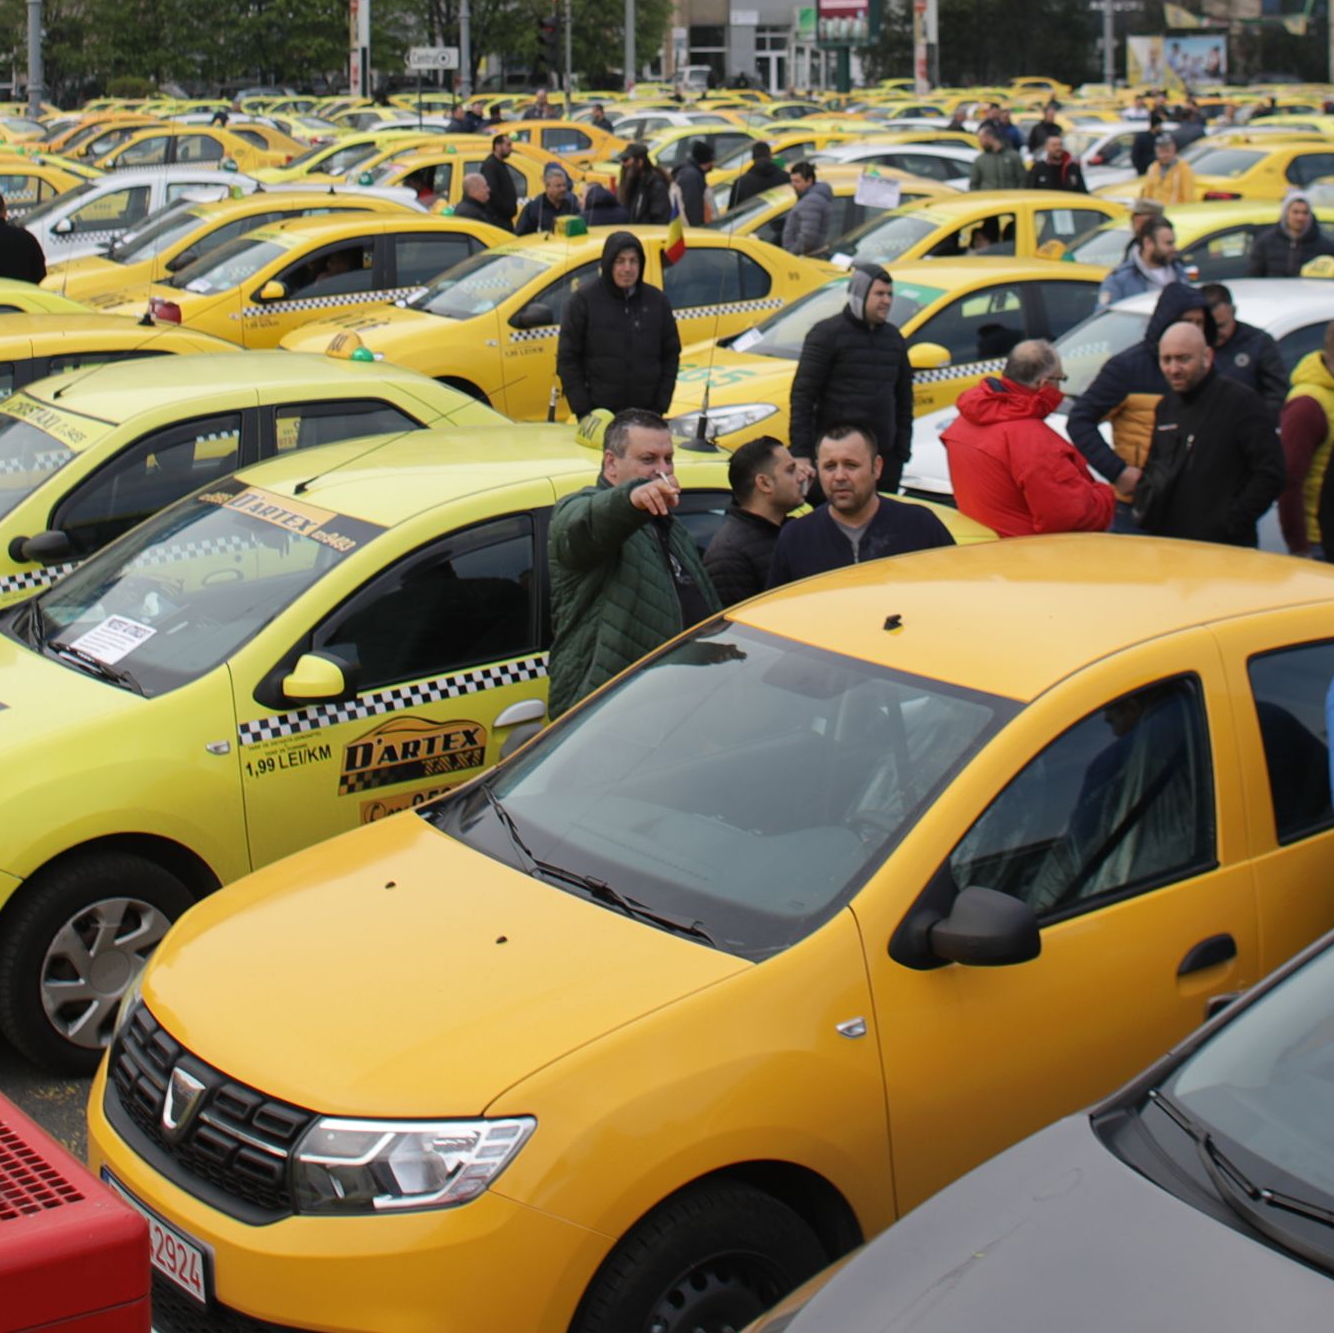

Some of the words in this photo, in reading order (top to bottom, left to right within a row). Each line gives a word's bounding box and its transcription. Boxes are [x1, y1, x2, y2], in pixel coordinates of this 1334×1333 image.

[227, 492, 318, 532] D'ARTEX
[246, 757, 275, 778] 1,99
[278, 744, 332, 770] LEI/KM
[346, 728, 480, 772] D'ARTEX
[149, 1228, 201, 1293] 2924
